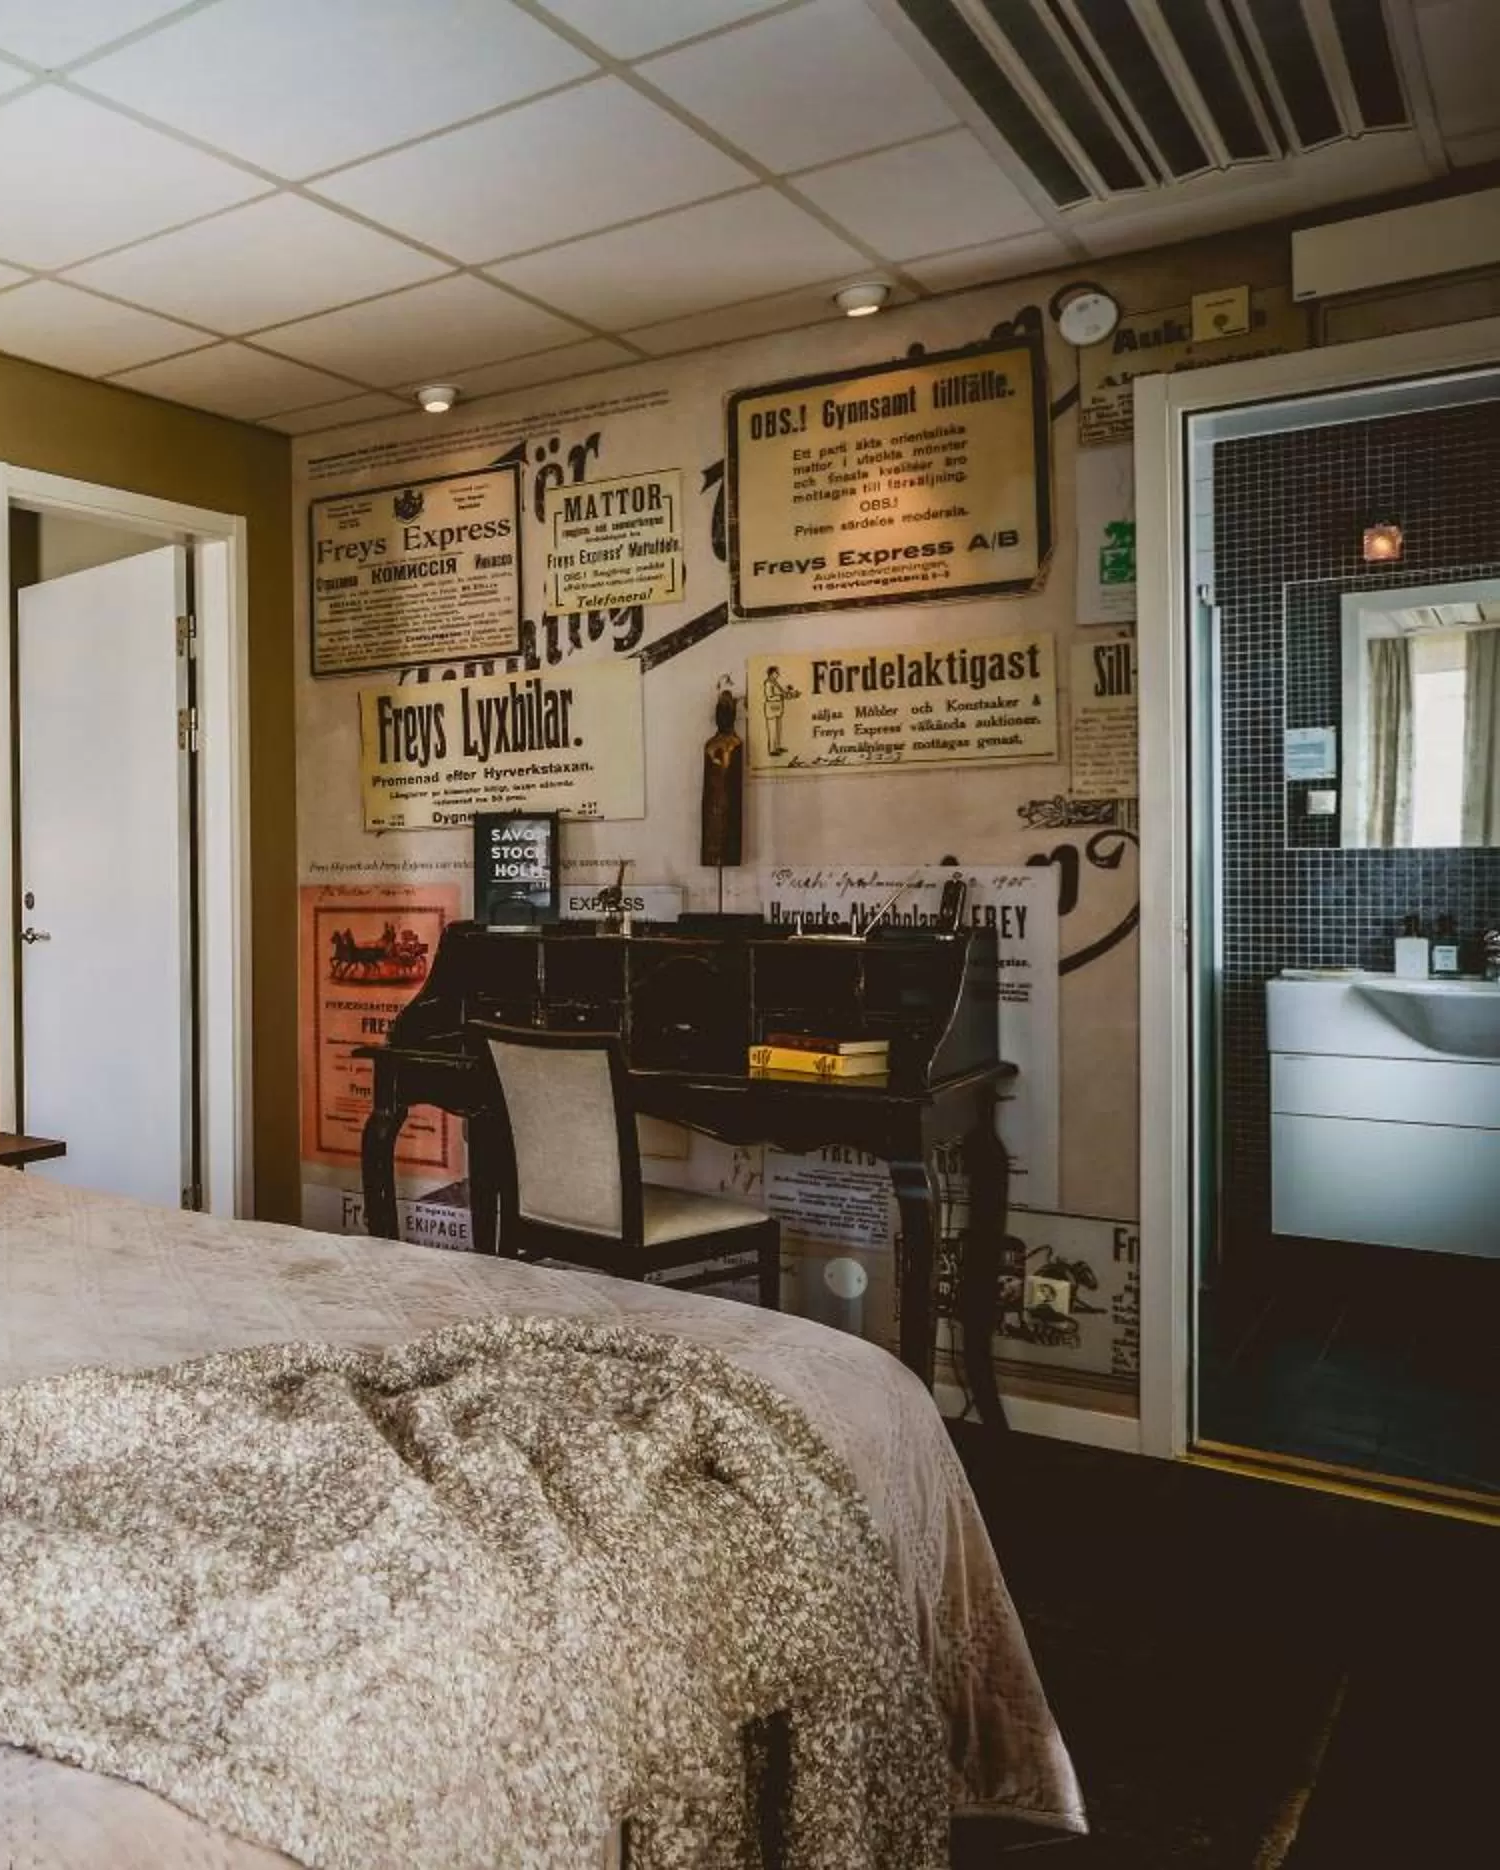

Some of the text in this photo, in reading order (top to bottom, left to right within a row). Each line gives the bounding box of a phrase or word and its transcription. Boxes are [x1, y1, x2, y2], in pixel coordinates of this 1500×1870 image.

[822, 384, 917, 431] Gynnsamt
[932, 369, 1016, 409] tillfälle.
[563, 483, 663, 523] MATTOR
[316, 517, 512, 565] Freys Express
[752, 528, 1020, 577] Freys Express A/B
[809, 642, 1042, 696] Fördelaktigast
[377, 677, 583, 768] Freys Lyxbilar.
[910, 700, 933, 715] och
[371, 771, 440, 788] Promenad
[483, 761, 595, 782] Hyrverkstaxan.
[432, 811, 479, 826] Dygne
[569, 896, 645, 912] EXPSS
[405, 1215, 468, 1239] EKIPAGE
